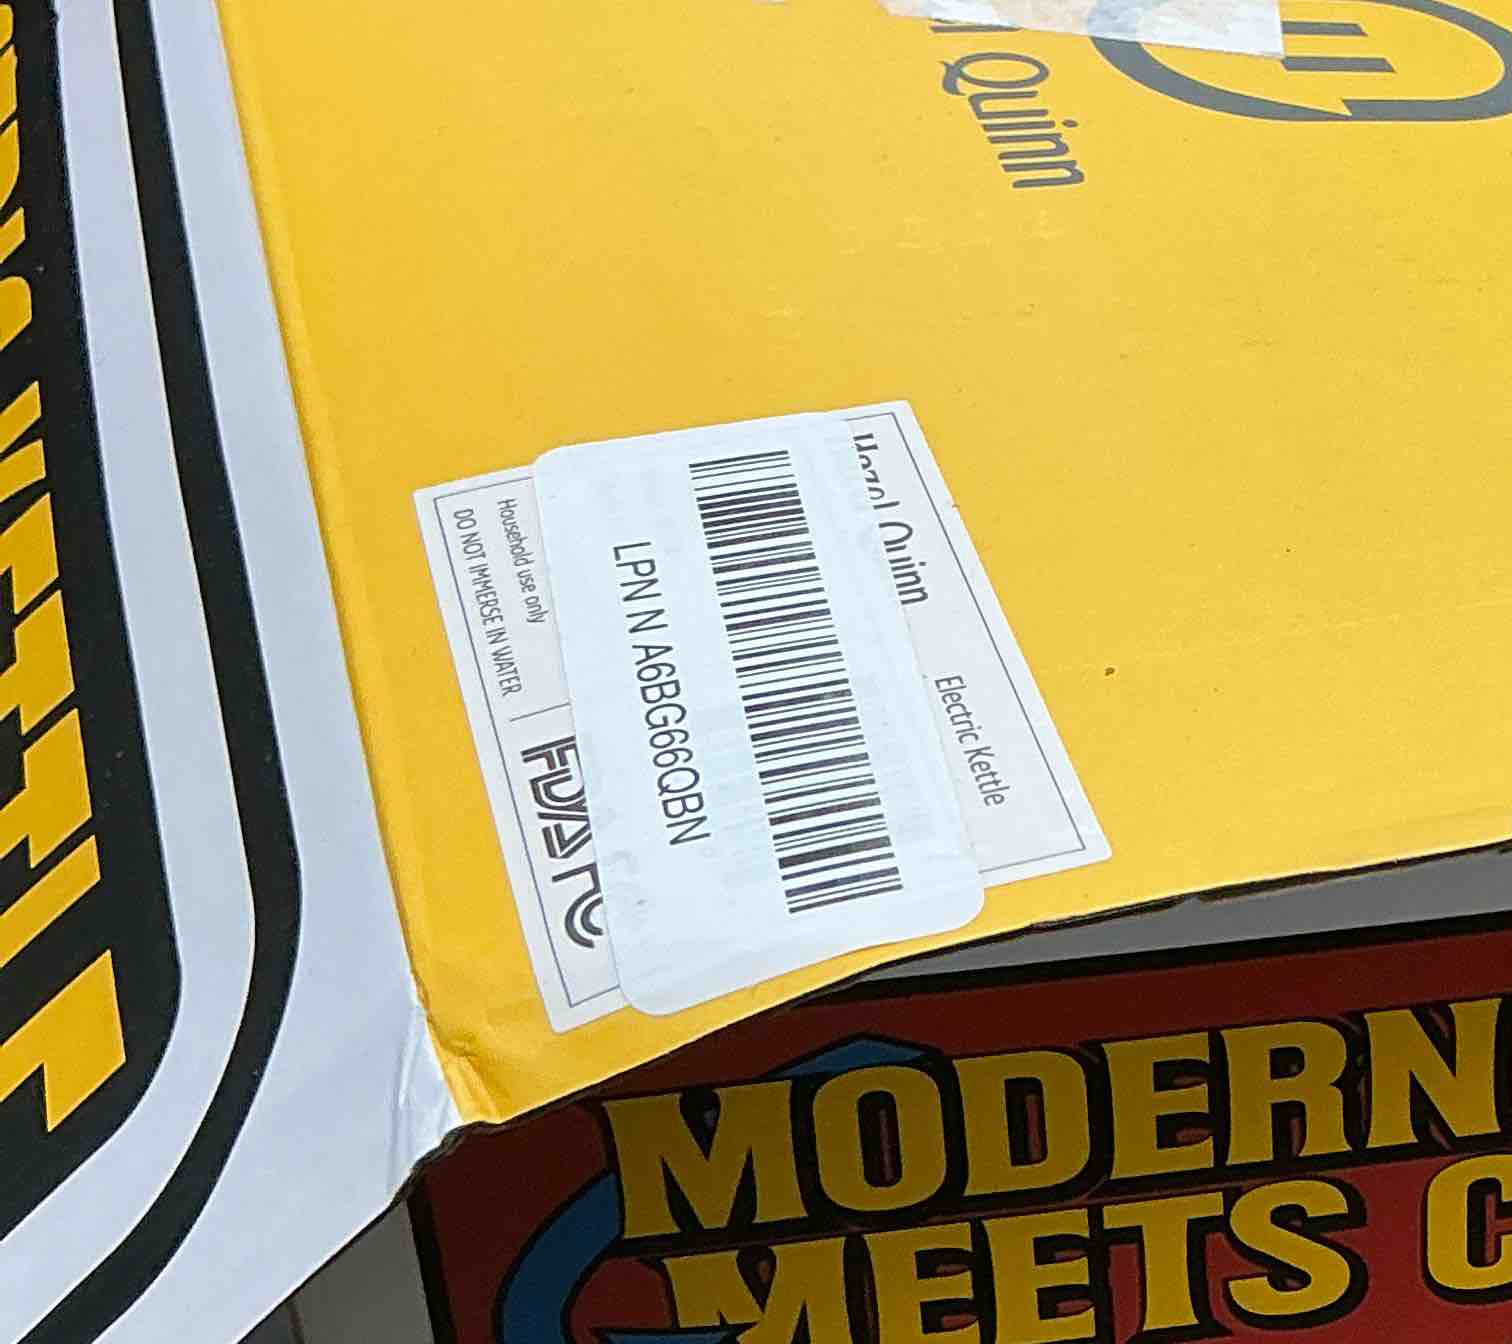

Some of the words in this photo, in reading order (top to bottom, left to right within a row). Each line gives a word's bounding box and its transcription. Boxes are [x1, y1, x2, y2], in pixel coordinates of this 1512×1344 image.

[936, 52, 1085, 189] Quinn
[453, 508, 477, 530] DO
[497, 498, 535, 567] Household
[460, 531, 487, 560] NOT
[468, 563, 503, 626] IMMERSE
[517, 568, 536, 593] use
[524, 596, 549, 623] only
[485, 627, 508, 645] IN
[491, 645, 522, 697] WATER
[632, 644, 711, 845] A6BG66QBN
[934, 674, 983, 743] Electric
[963, 745, 1011, 807] Kettle
